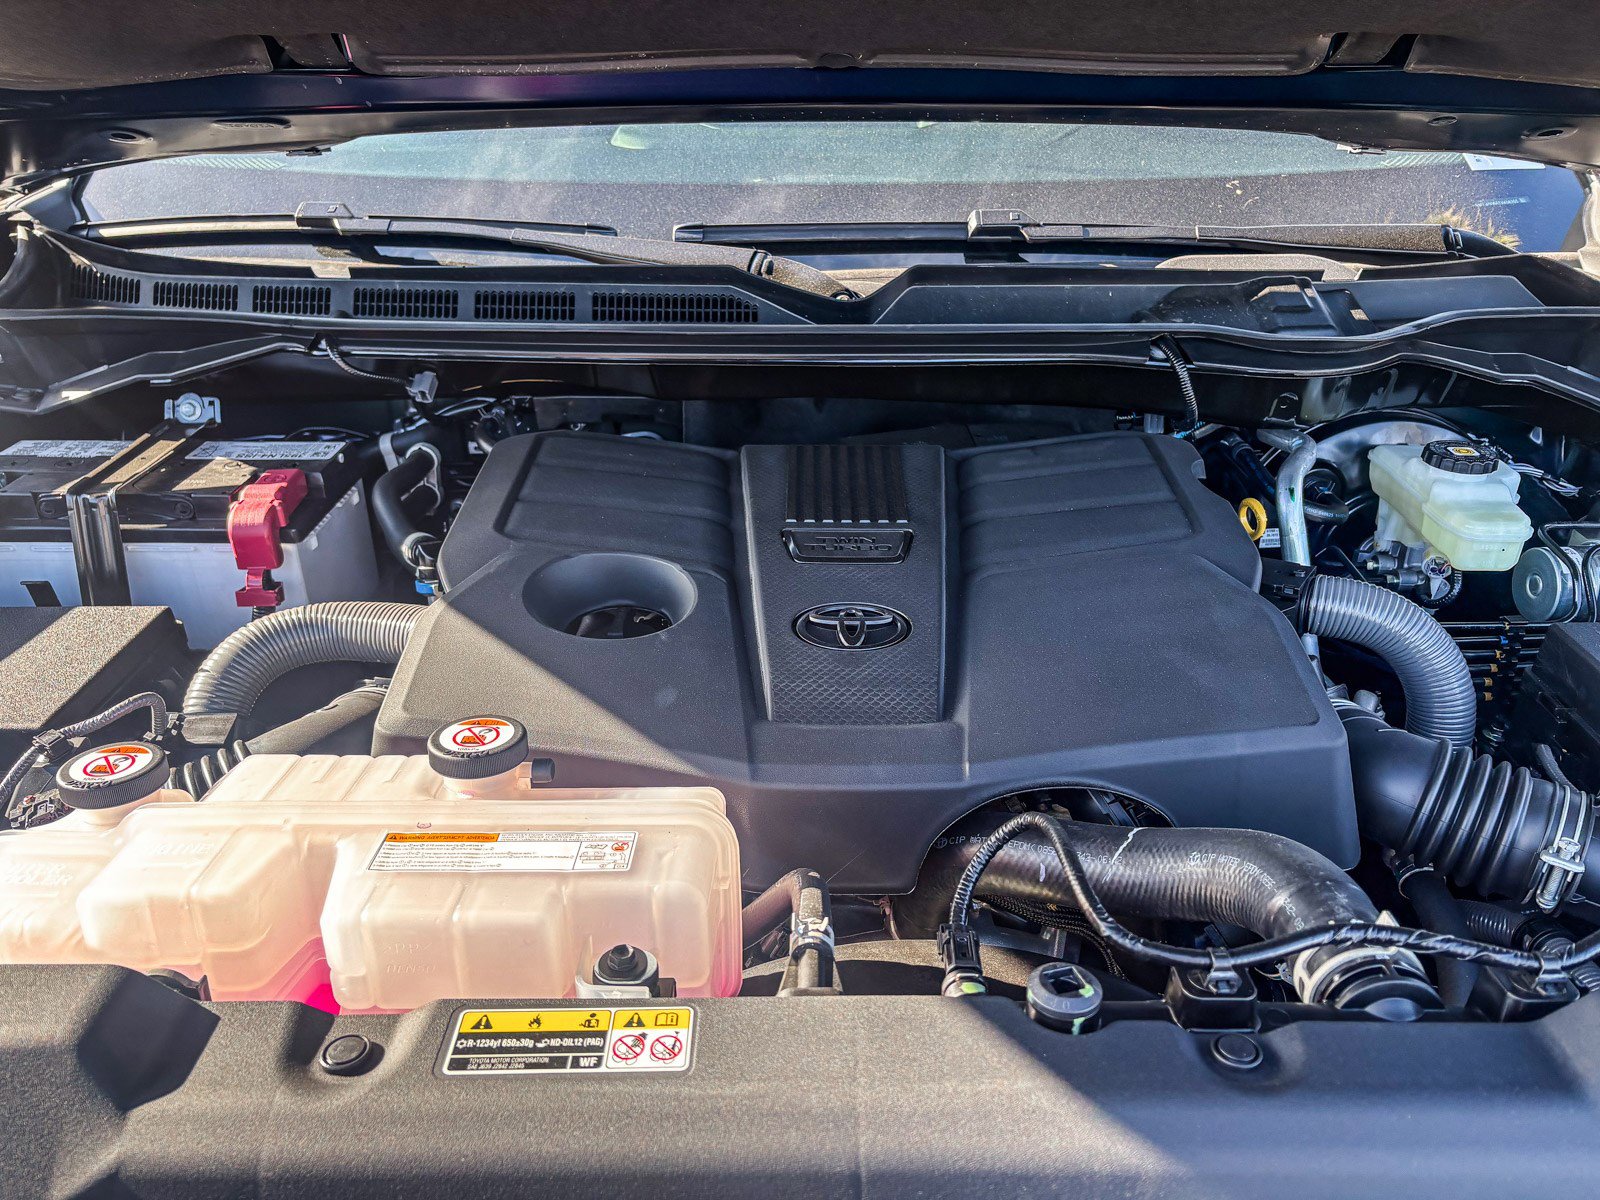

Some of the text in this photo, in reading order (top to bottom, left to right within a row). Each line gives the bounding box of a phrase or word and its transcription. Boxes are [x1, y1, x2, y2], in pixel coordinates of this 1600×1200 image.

[949, 836, 966, 845] CIP
[1201, 853, 1216, 863] CIP
[1217, 853, 1240, 867] WATER
[467, 1038, 501, 1049] R-1234yf
[583, 1037, 604, 1048] (PAG)
[579, 1056, 599, 1067] WF
